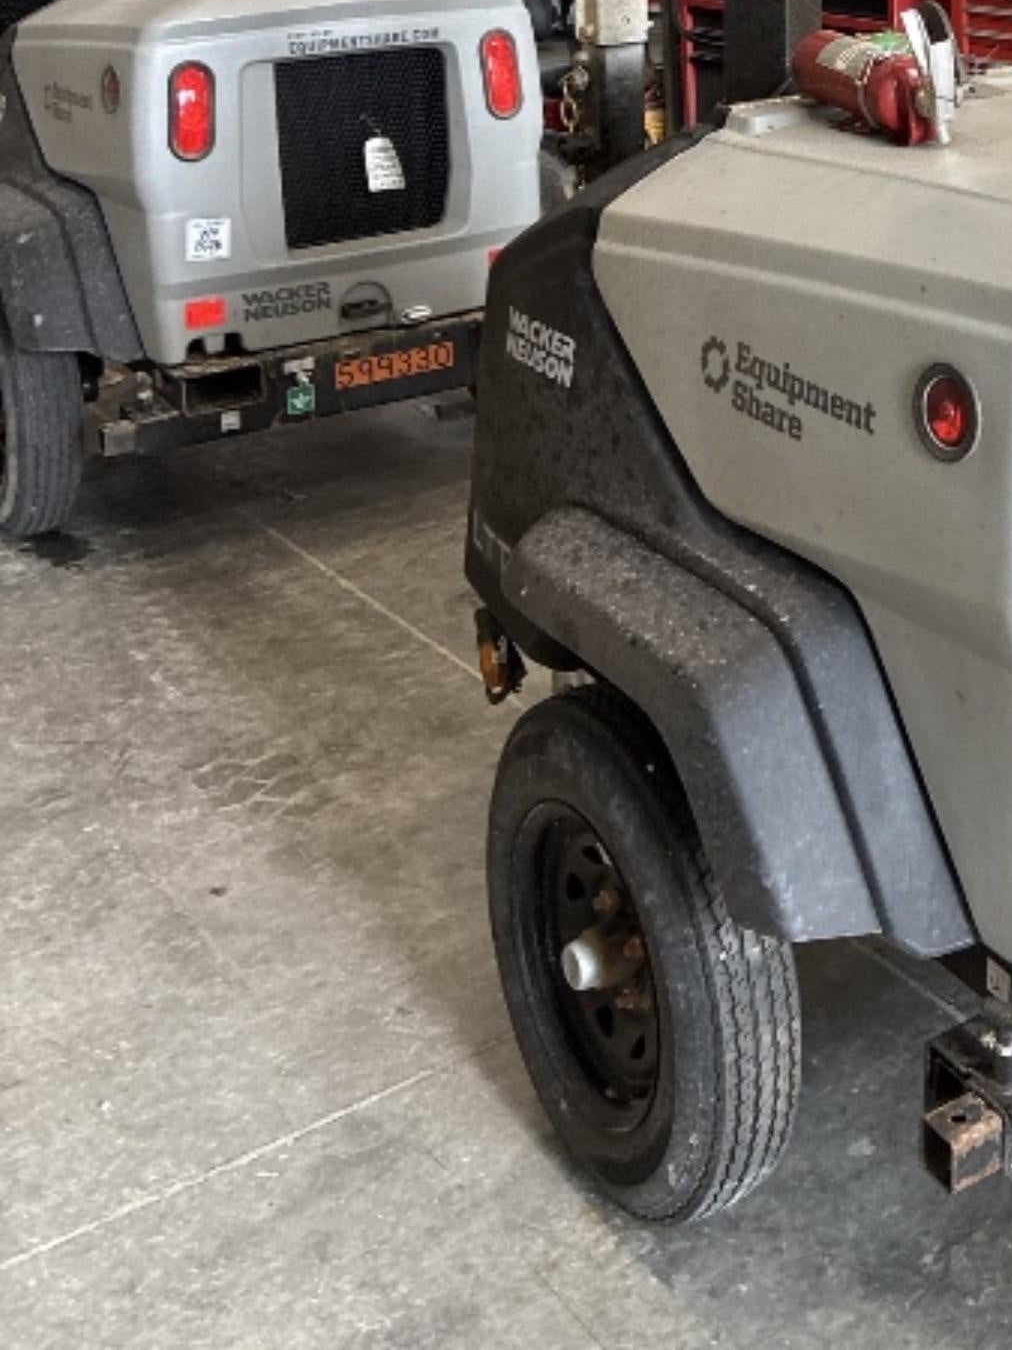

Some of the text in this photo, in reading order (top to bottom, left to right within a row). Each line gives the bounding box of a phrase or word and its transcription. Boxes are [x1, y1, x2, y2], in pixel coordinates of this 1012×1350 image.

[508, 305, 576, 362] WACKER
[731, 380, 802, 441] Share
[735, 341, 876, 435] Equipment
